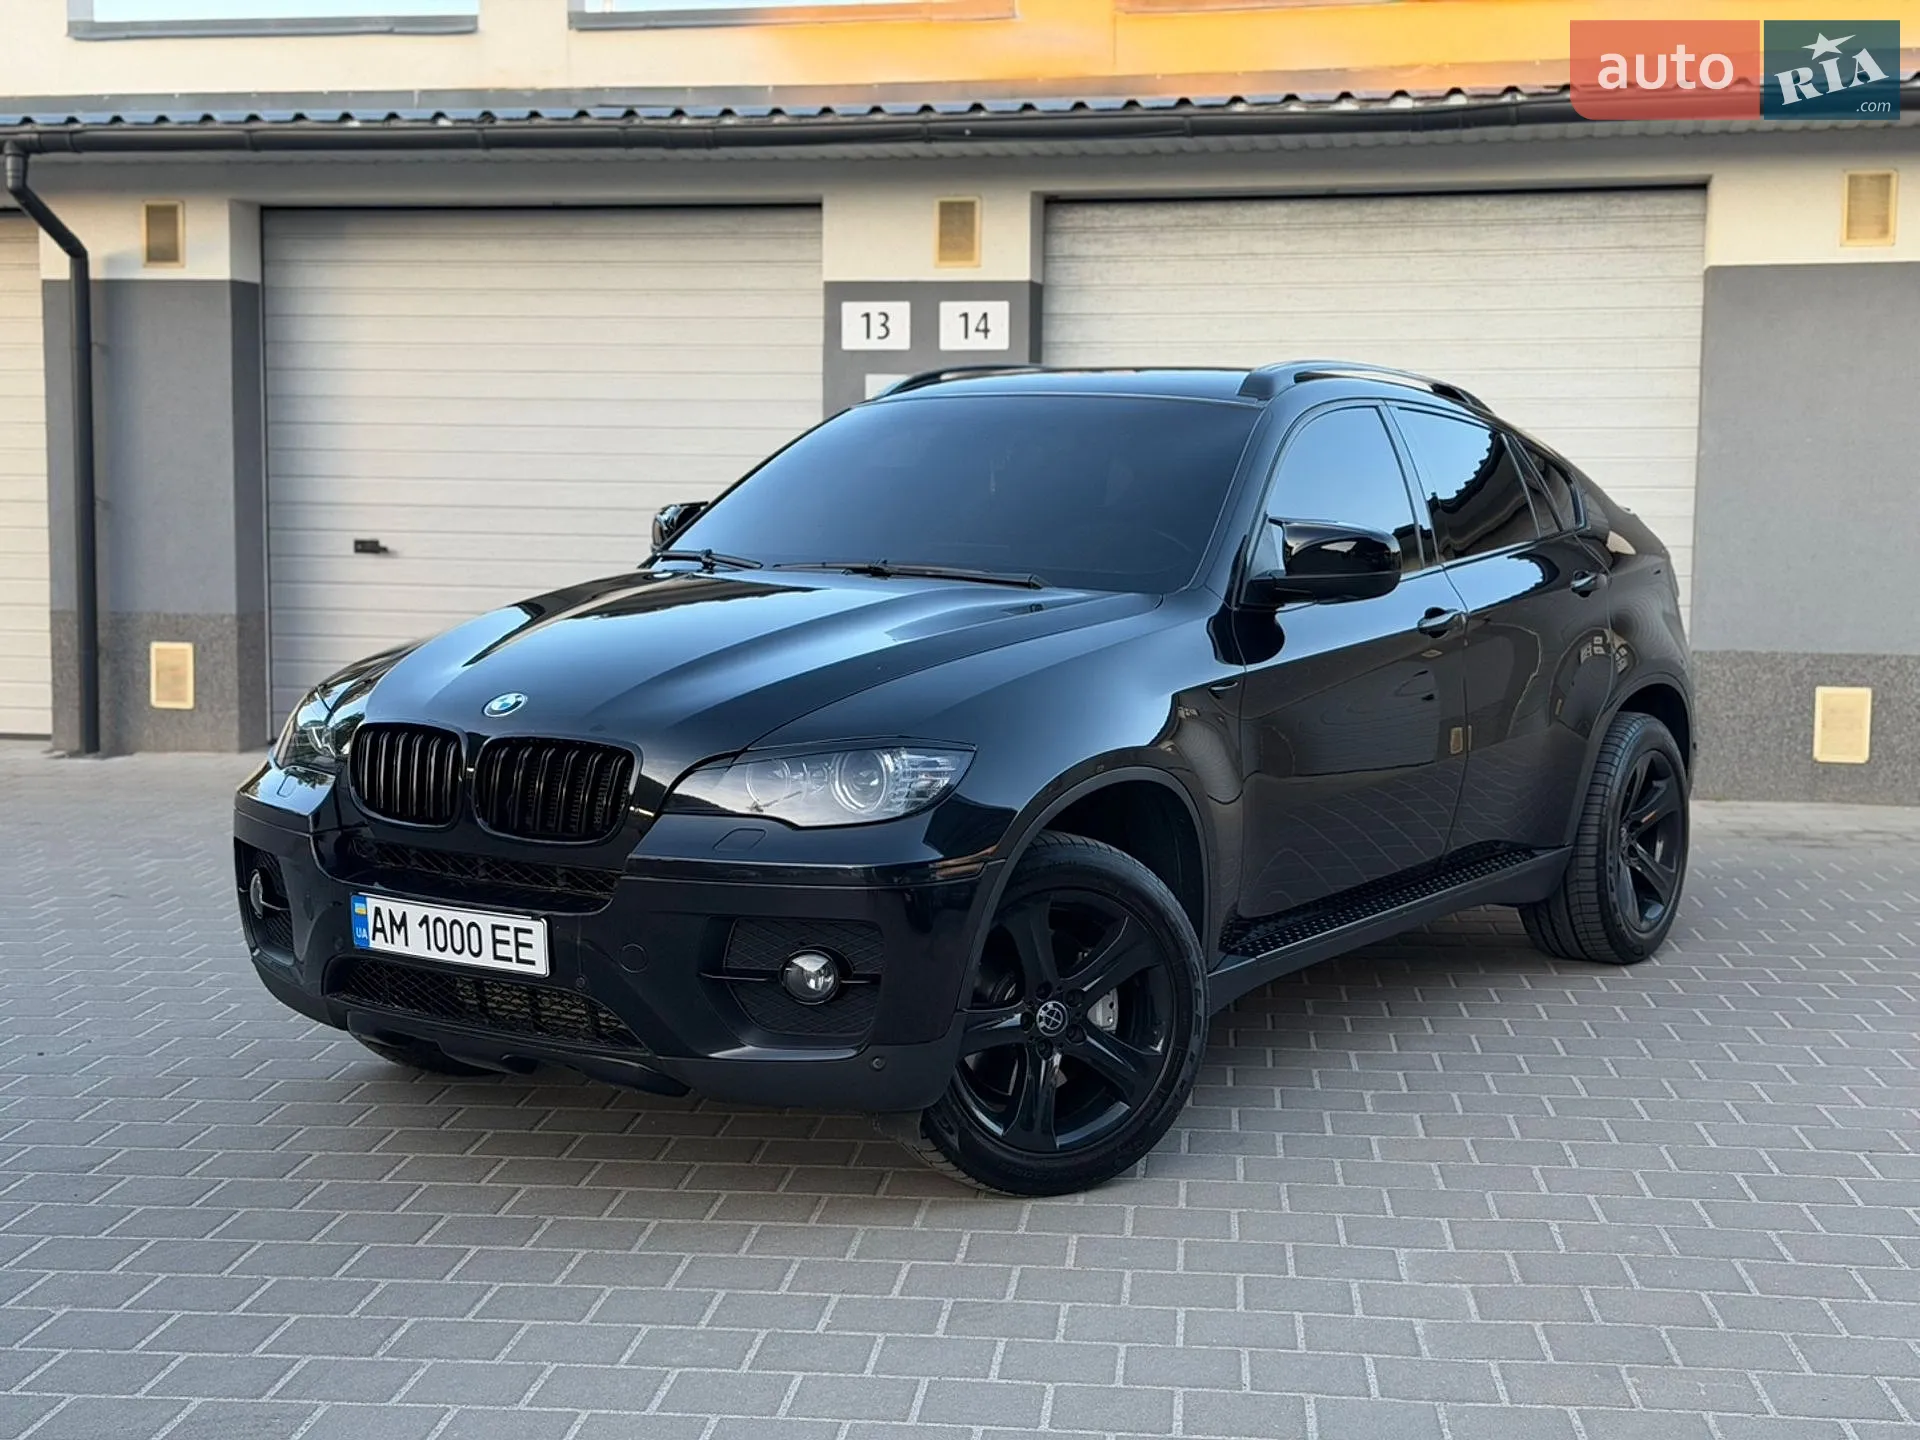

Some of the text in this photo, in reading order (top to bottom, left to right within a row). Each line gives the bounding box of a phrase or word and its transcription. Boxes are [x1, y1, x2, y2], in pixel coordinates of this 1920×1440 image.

[860, 311, 891, 340] 13
[958, 311, 991, 340] 14
[355, 927, 368, 940] UA
[371, 906, 536, 966] AM 1000 EE
